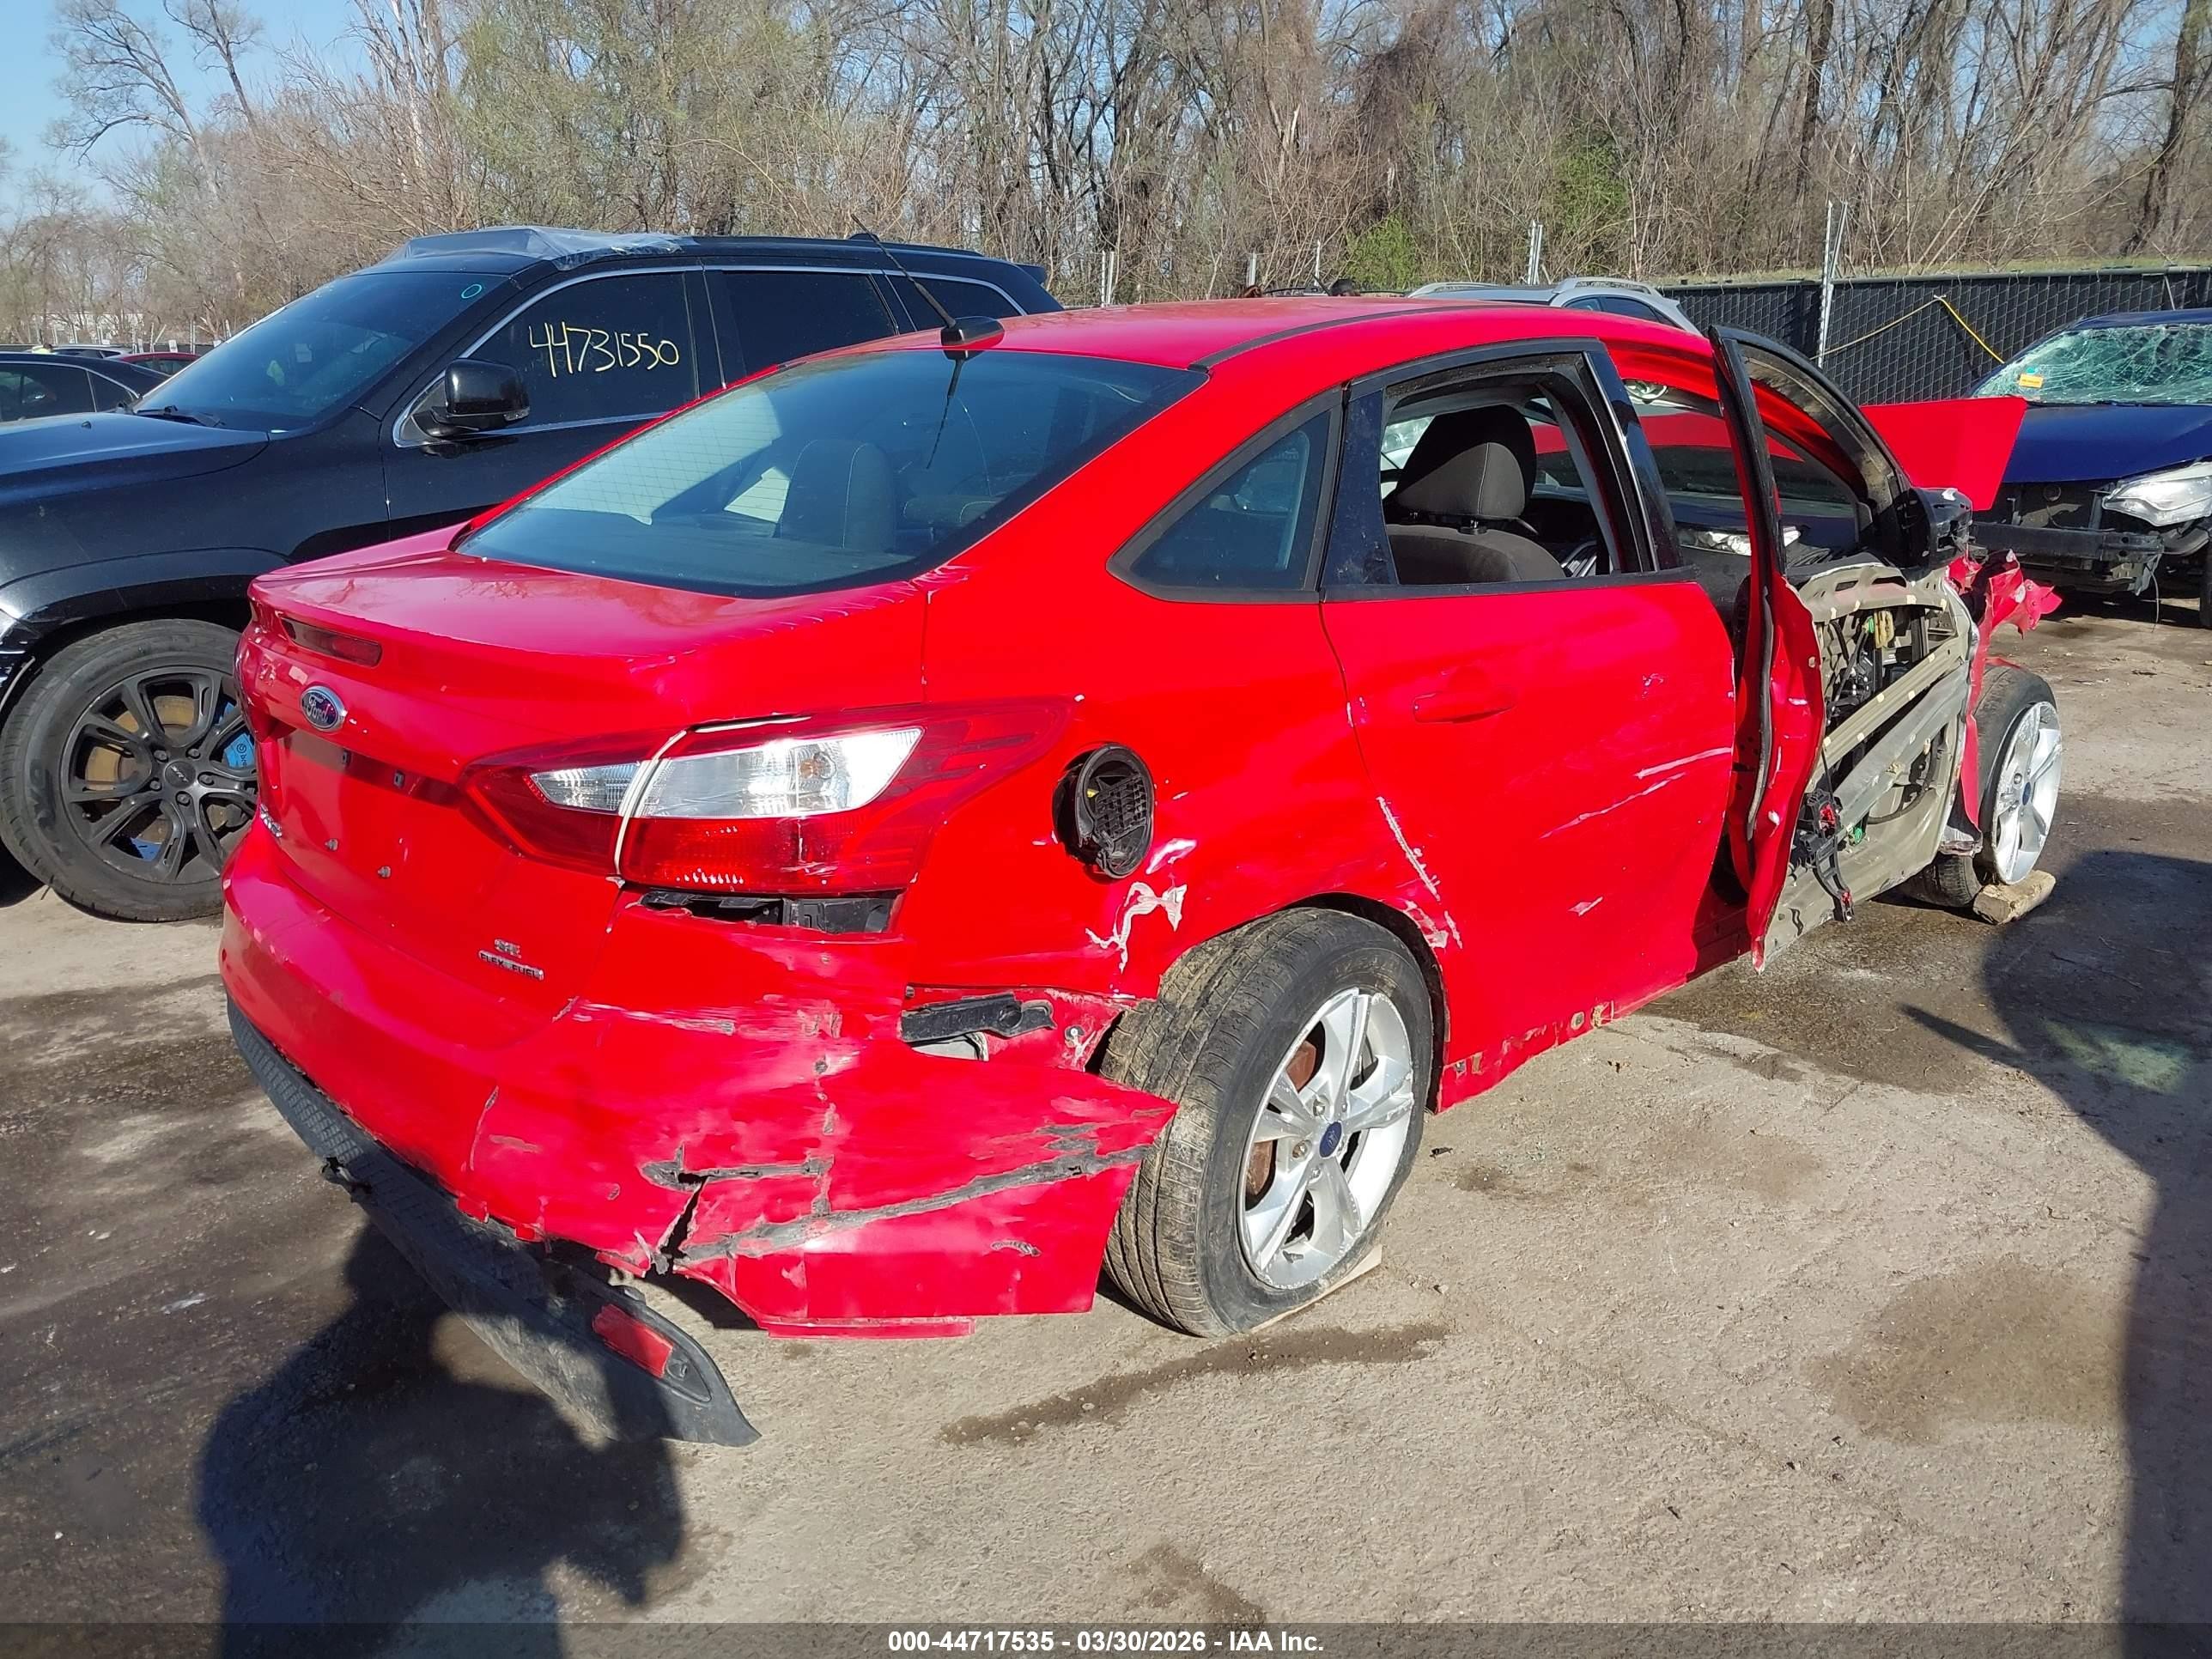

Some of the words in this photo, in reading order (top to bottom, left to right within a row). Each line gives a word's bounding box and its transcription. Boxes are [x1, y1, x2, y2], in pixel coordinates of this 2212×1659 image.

[528, 321, 679, 378] 44731550
[306, 694, 329, 723] Ford
[480, 952, 504, 969] FLEX
[512, 963, 541, 981] FUEL
